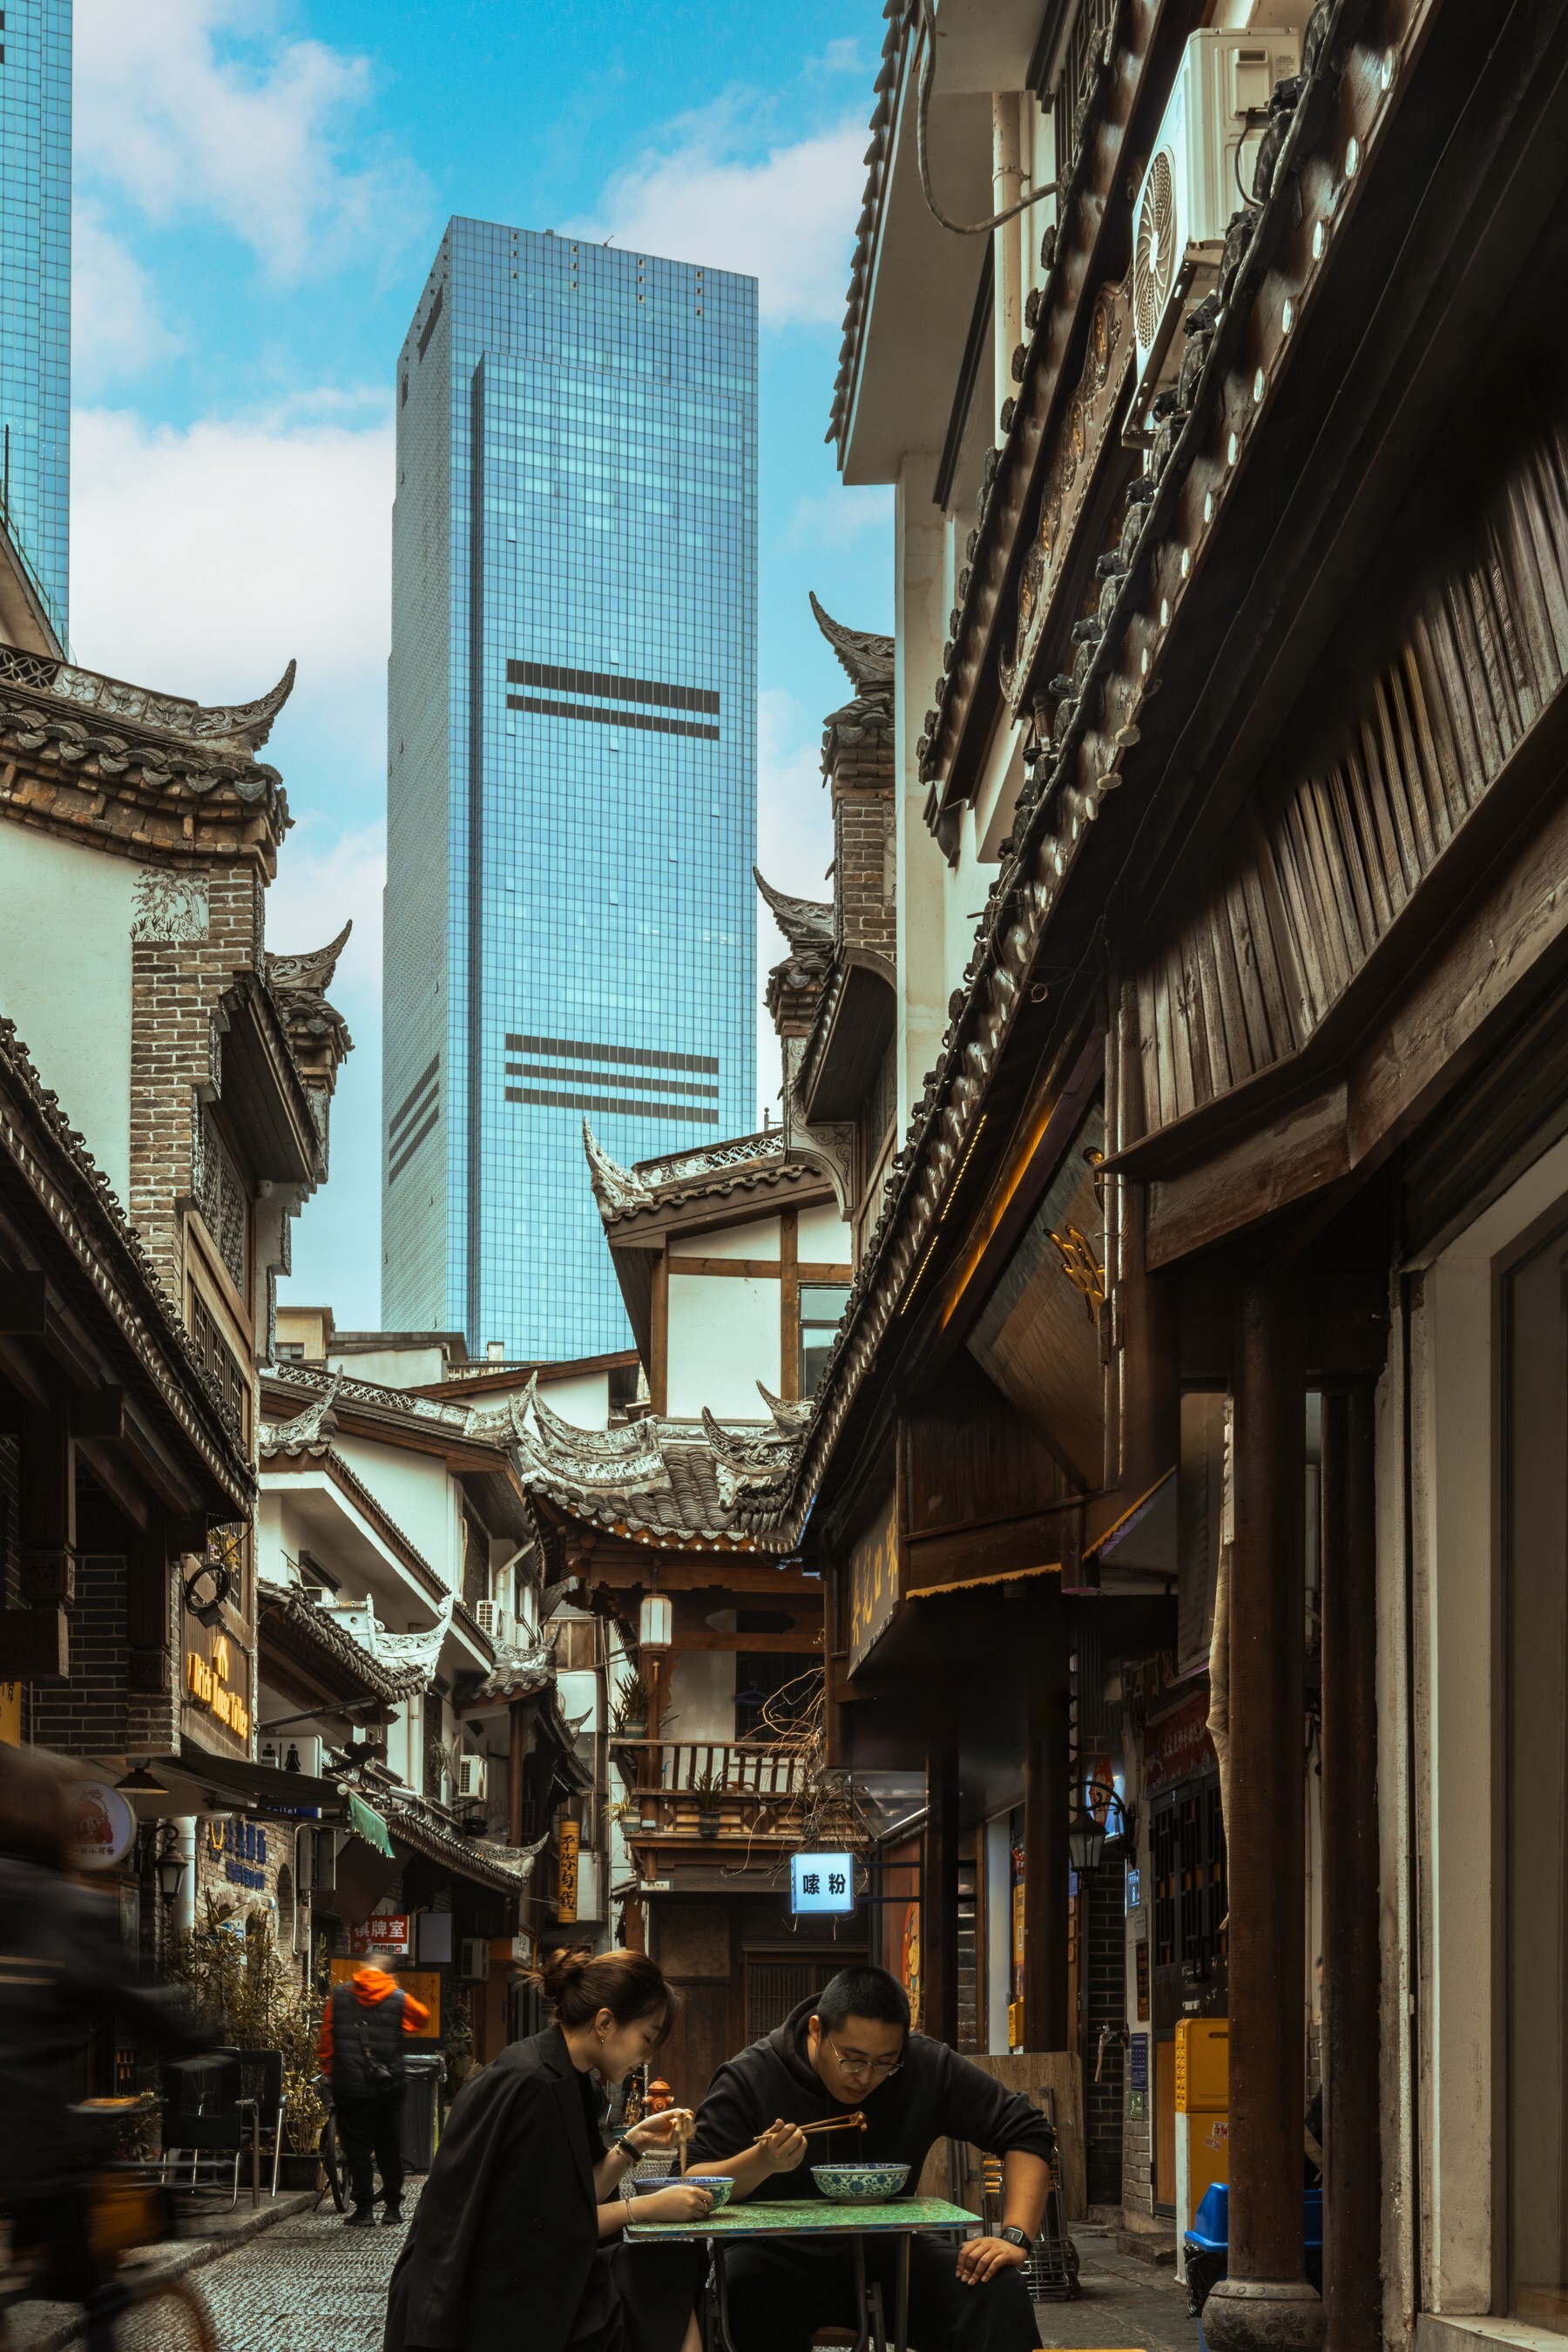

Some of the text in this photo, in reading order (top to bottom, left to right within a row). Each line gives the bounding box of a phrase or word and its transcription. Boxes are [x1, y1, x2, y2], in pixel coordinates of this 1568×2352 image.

[802, 1873, 846, 1895] 嗦粉
[354, 1920, 405, 1938] 棋牌室
